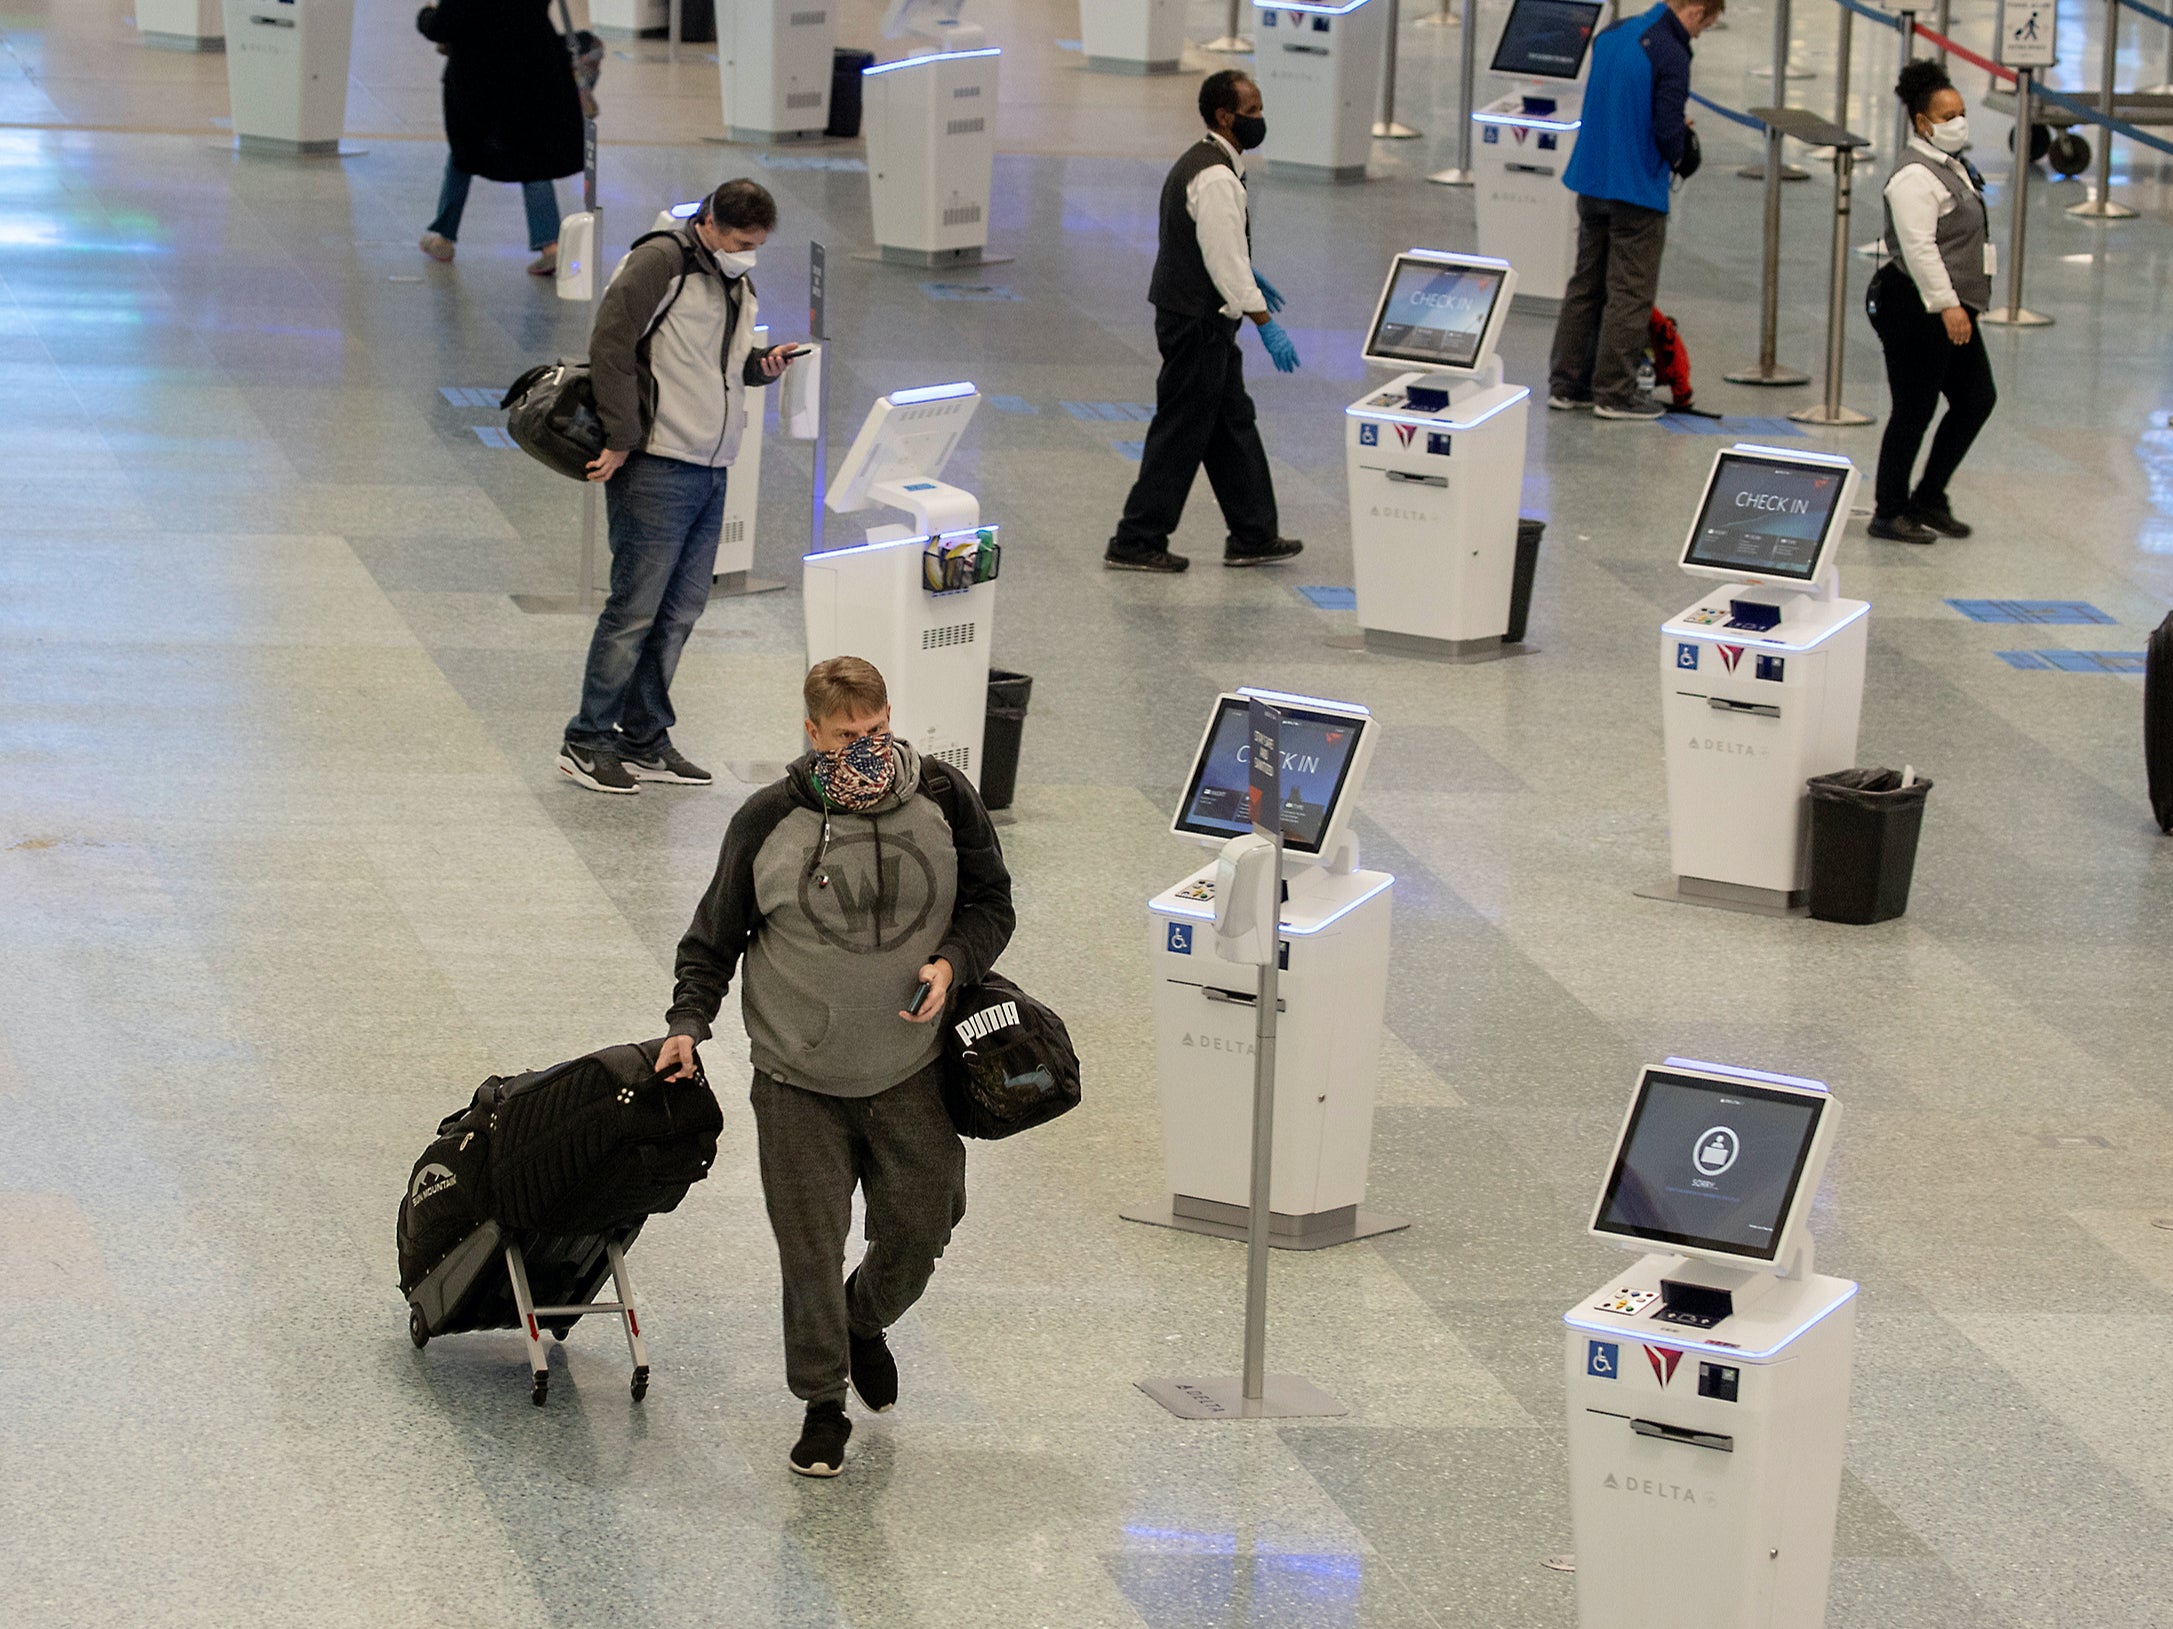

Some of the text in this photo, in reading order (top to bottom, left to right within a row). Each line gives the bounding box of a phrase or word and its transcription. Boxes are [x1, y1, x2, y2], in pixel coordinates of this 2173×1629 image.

[1410, 290, 1474, 311] CHECK IN
[1735, 491, 1809, 514] CHECK IN
[1704, 738, 1754, 756] DELTA
[1297, 752, 1320, 774] IN
[820, 853, 903, 934] W
[954, 1000, 1021, 1048] PUMA
[1200, 1034, 1257, 1057] DELTA
[1626, 1476, 1696, 1504] DELTA
